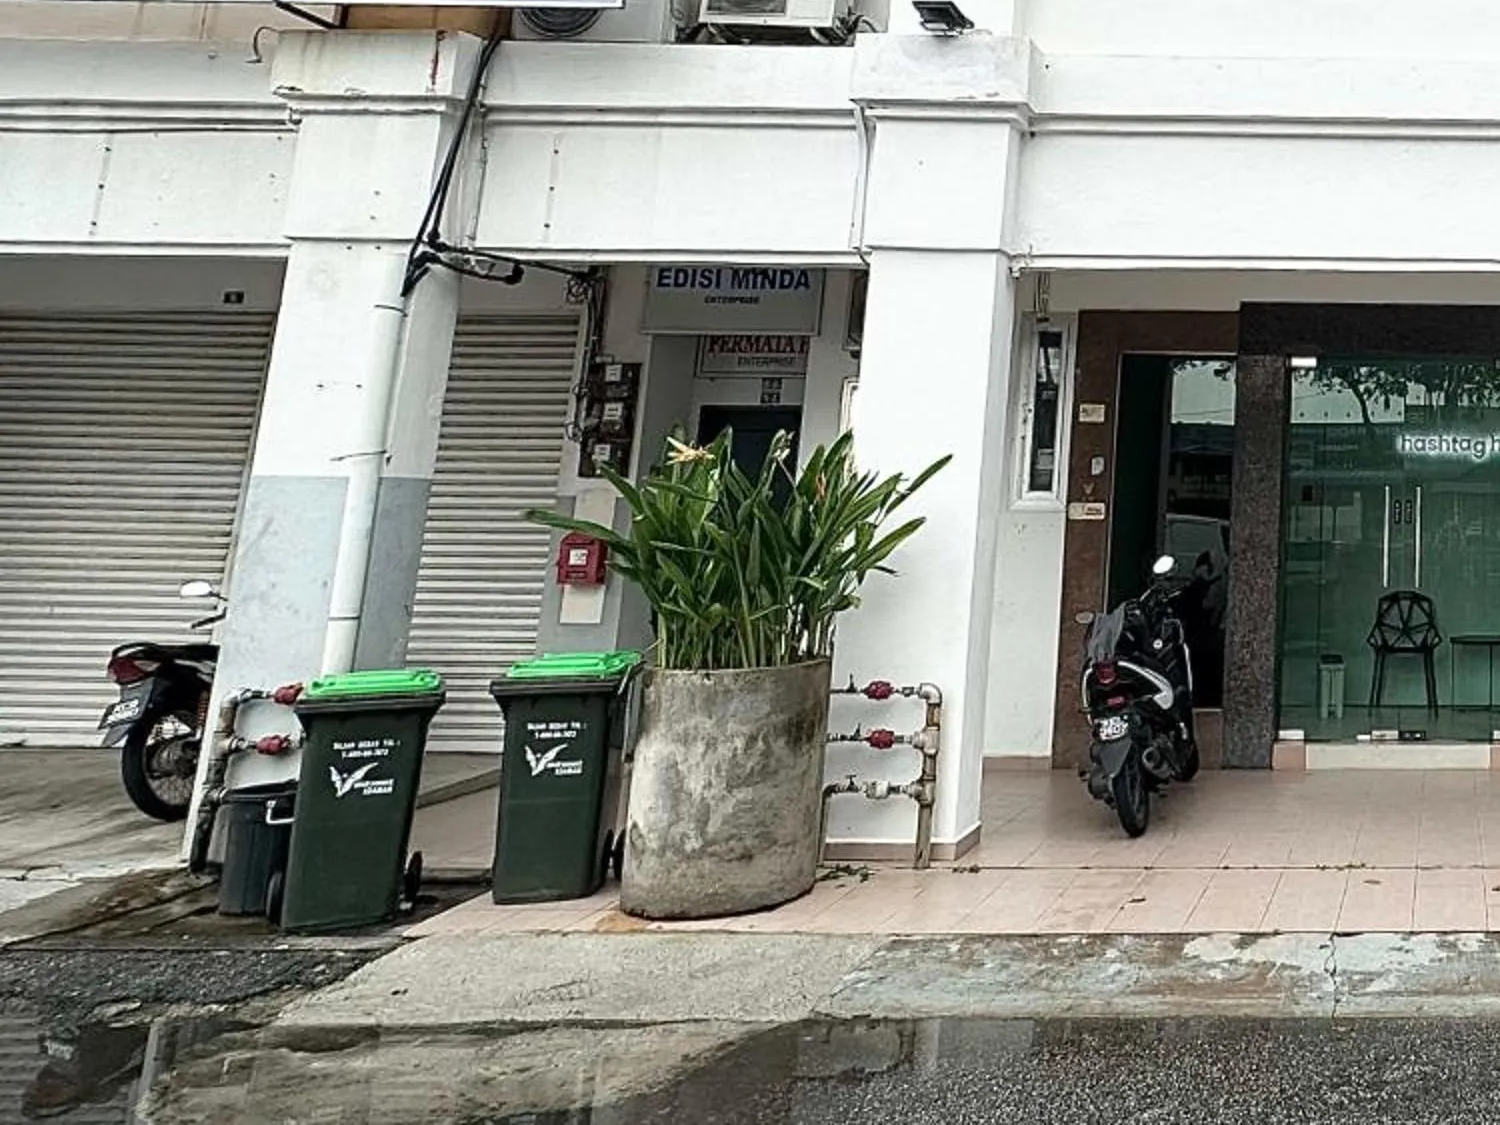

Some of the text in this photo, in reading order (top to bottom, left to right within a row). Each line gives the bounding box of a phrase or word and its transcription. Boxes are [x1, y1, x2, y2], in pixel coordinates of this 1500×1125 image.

[655, 267, 811, 291] EDISI MINDA
[1401, 433, 1486, 460] hashtag
